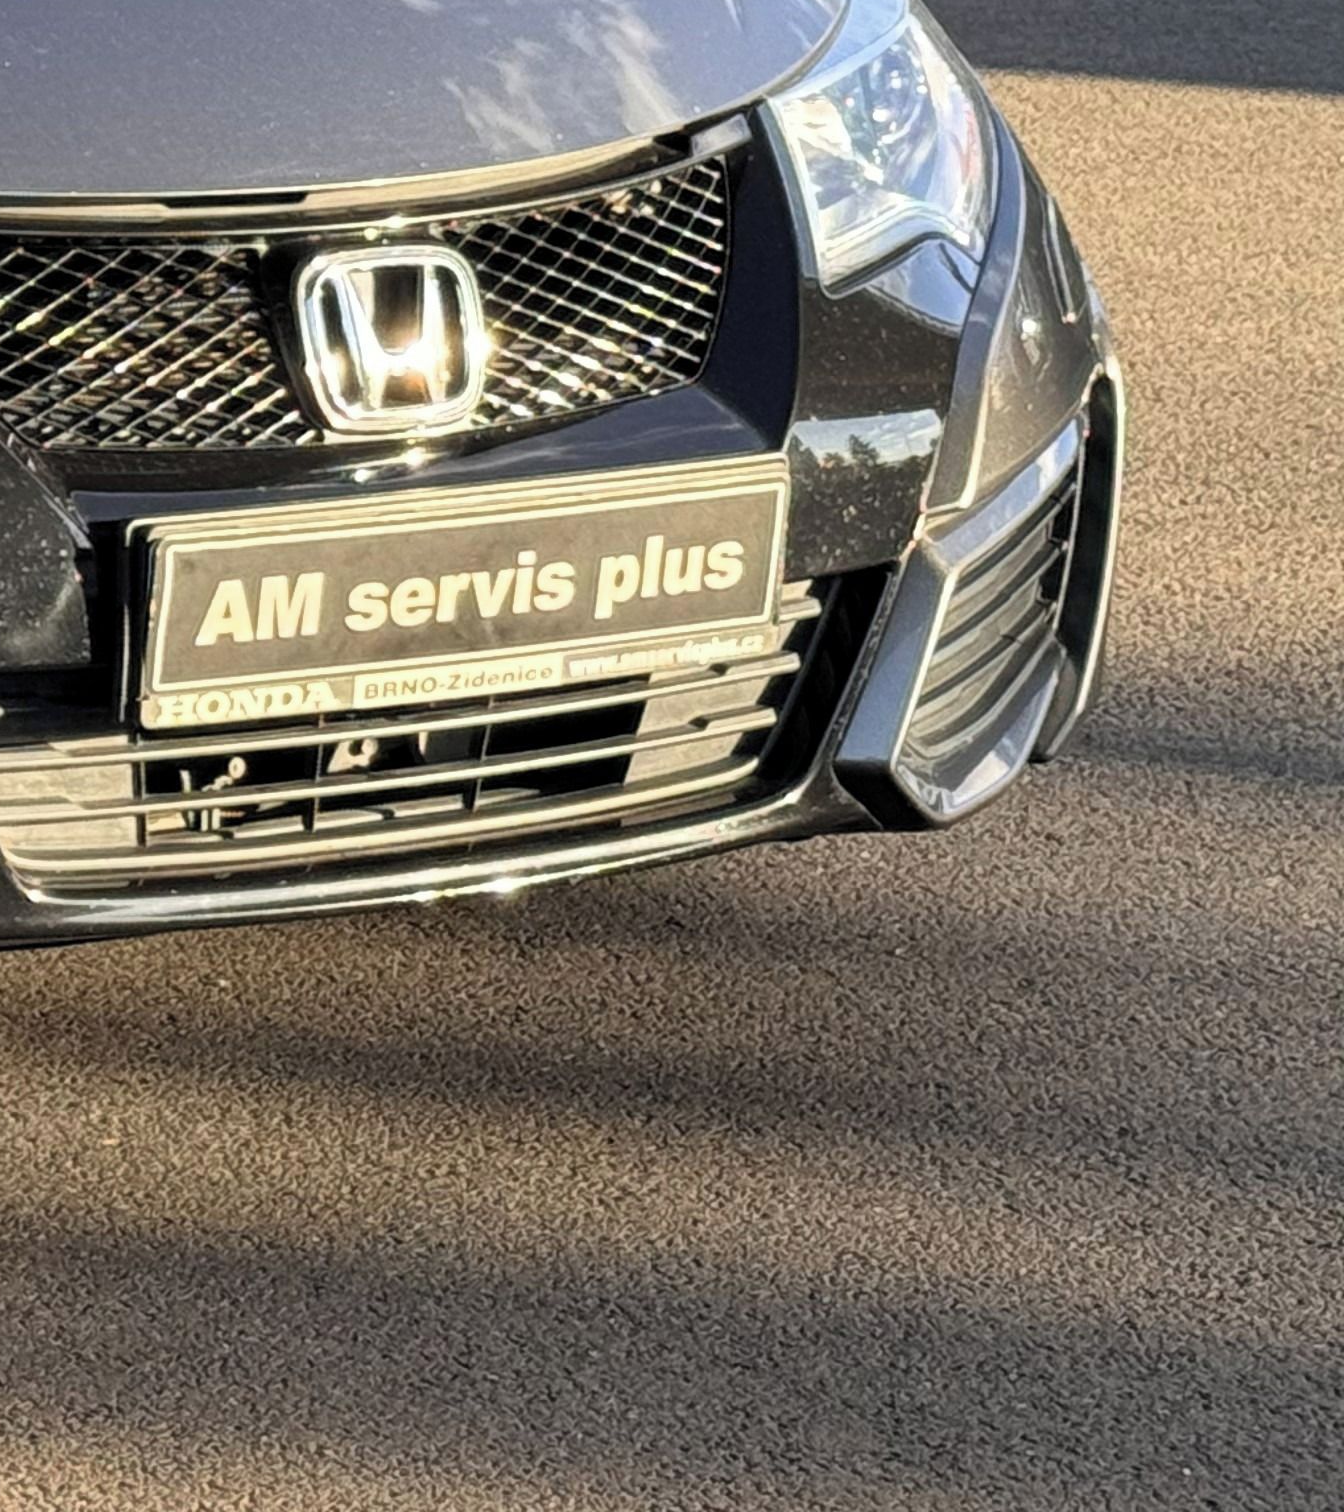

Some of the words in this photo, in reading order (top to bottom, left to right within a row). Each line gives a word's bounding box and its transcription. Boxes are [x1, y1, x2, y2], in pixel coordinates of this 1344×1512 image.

[195, 572, 325, 646] AM
[344, 550, 575, 632] servis
[593, 535, 744, 619] plus
[157, 681, 342, 729] HONDA
[364, 665, 553, 700] BRNO-Zidenice
